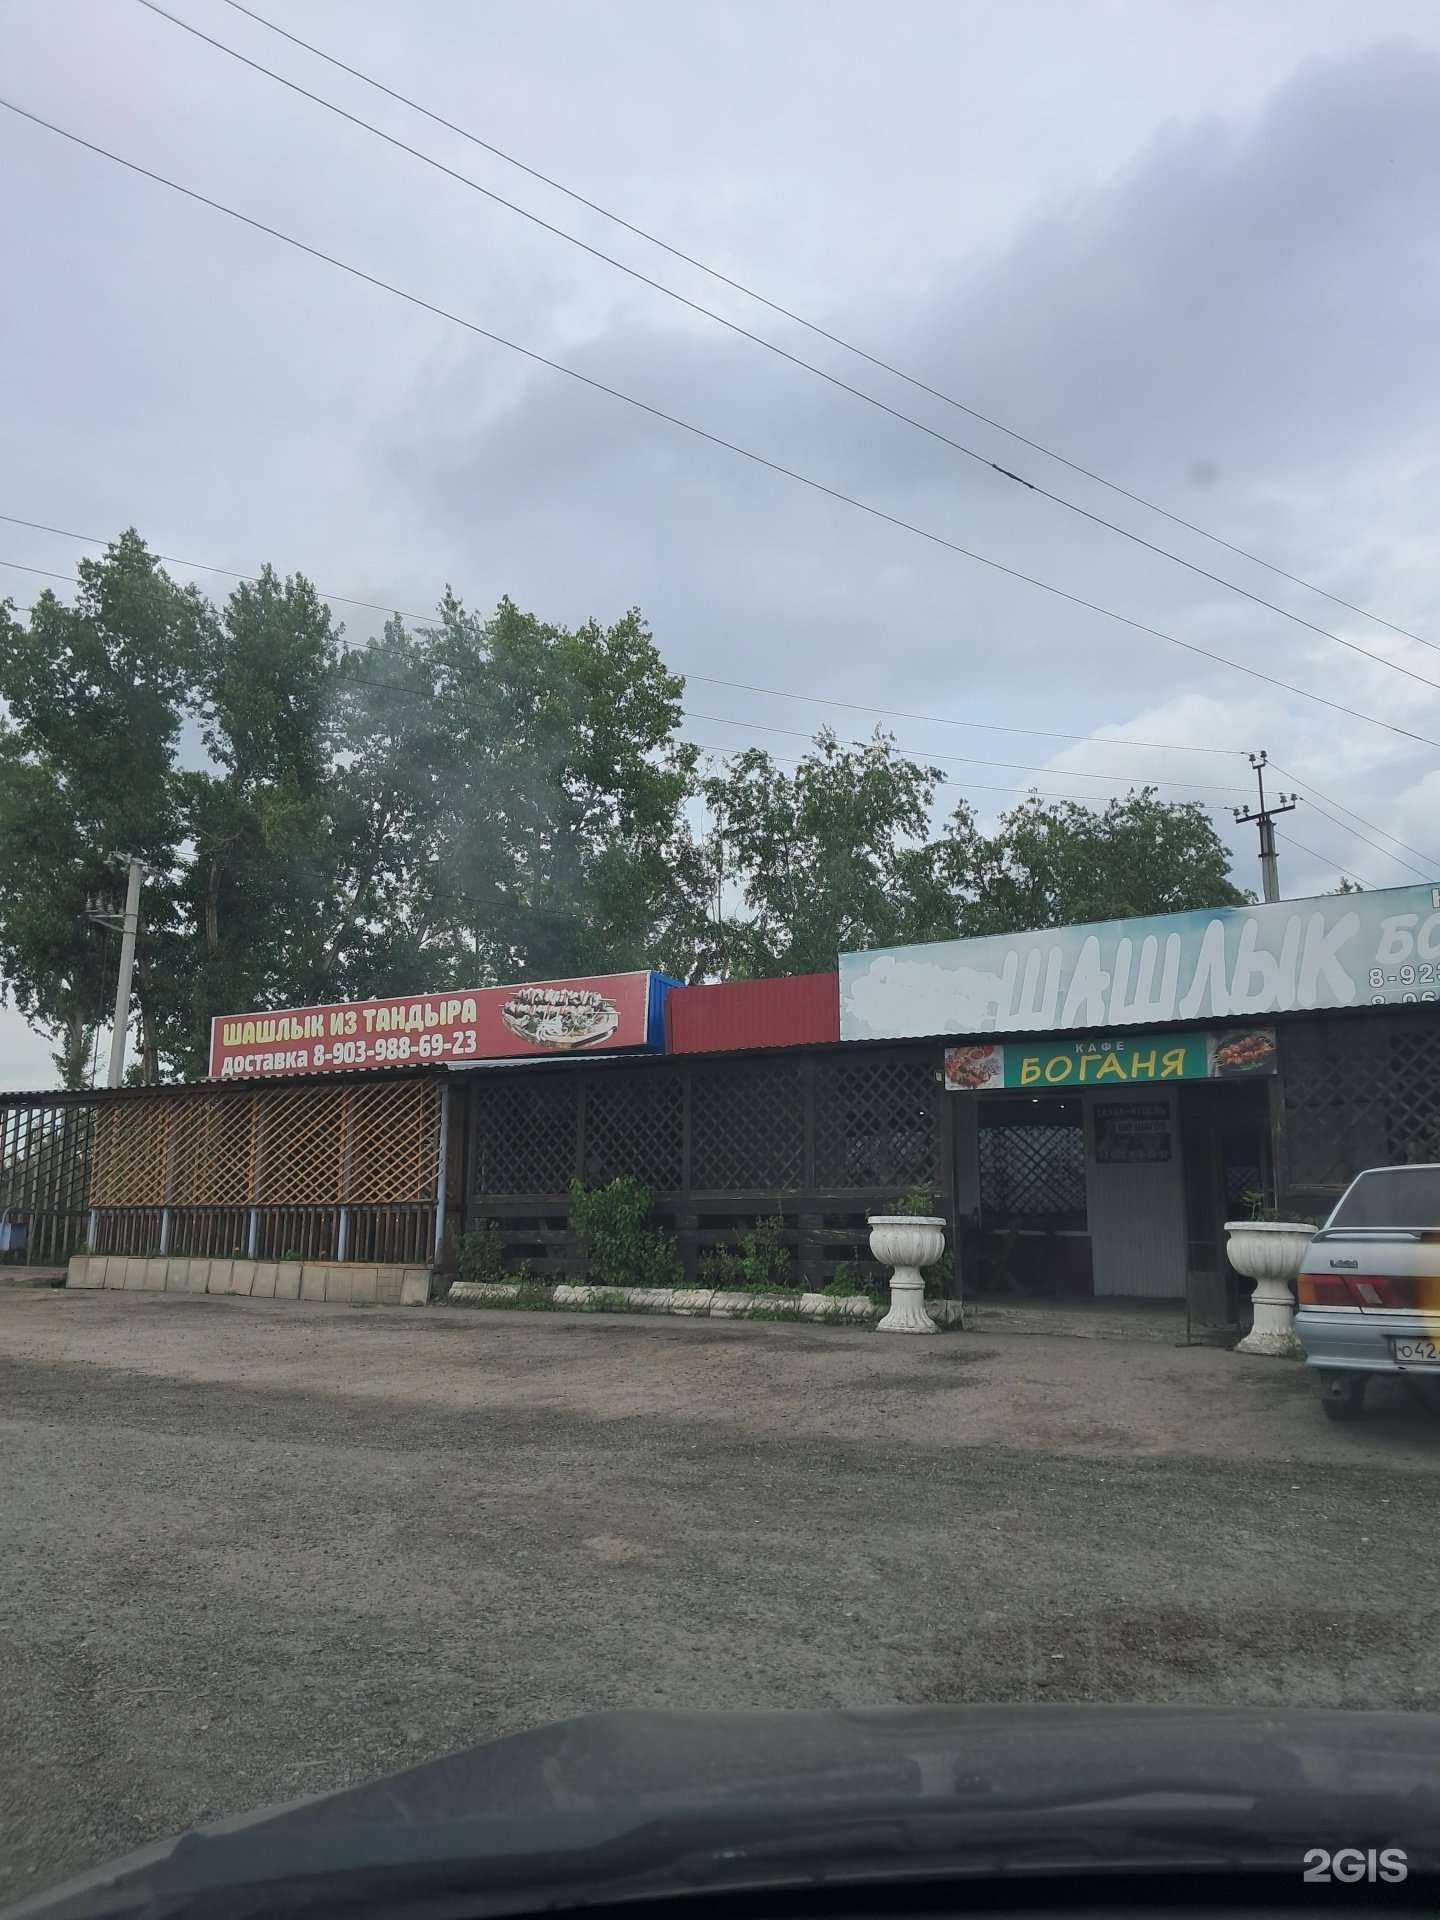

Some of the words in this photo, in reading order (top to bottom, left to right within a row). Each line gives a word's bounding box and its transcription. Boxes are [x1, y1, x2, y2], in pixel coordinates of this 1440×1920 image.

[996, 912, 1361, 1028] ШАШЛЫК
[222, 1013, 324, 1047] ШАШЛЫК
[329, 1010, 358, 1036] ИЗ
[362, 998, 477, 1034] ТАНДЫРА
[220, 1048, 308, 1077] доставка
[313, 1030, 477, 1066] 8-903-988-69-23
[1020, 1048, 1187, 1085] БОГАНЯ
[1074, 1041, 1125, 1054] КАФЕ
